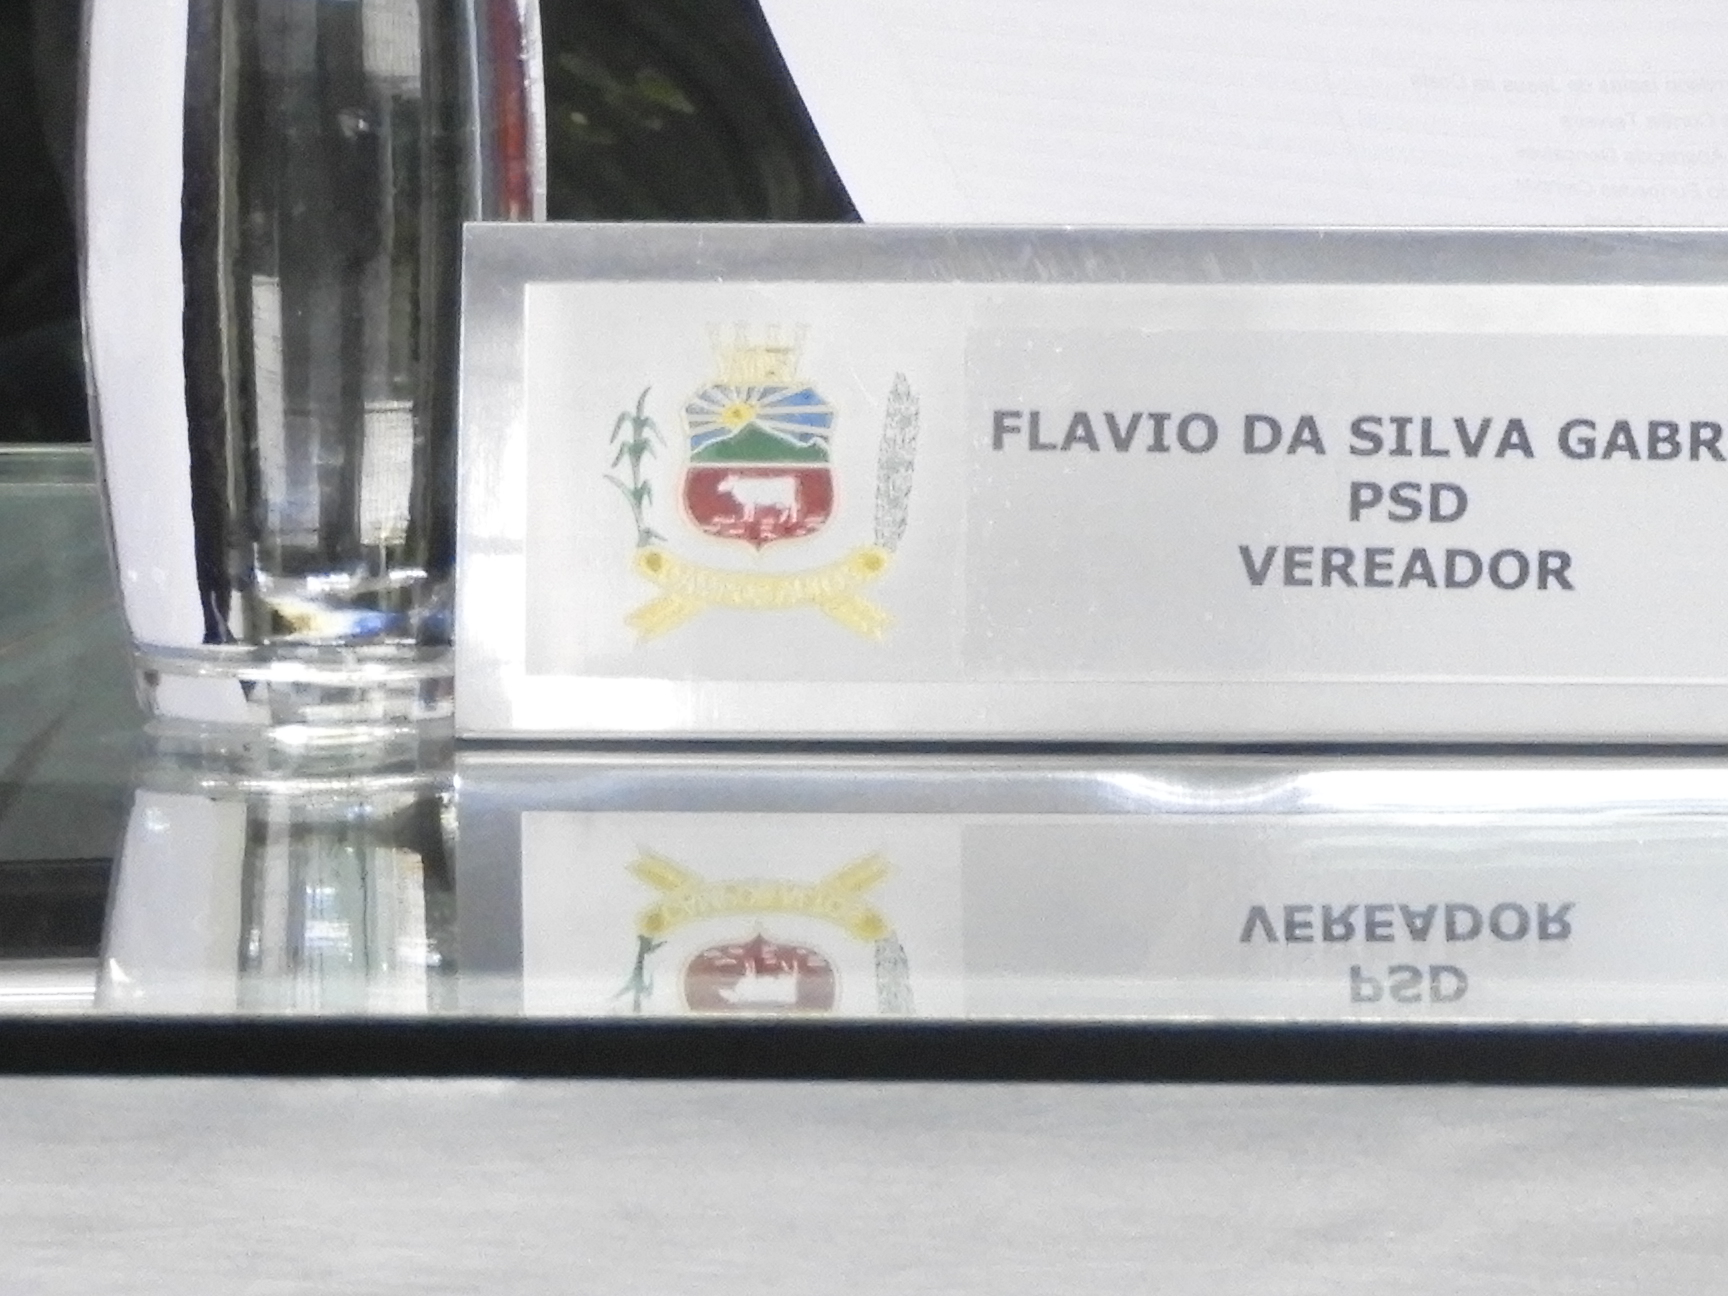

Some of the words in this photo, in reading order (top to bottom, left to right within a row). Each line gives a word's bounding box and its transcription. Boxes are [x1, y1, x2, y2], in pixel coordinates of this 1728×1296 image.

[993, 411, 1218, 454] FLAVIO
[1244, 414, 1325, 455] DA
[1350, 416, 1534, 458] SILVA
[1350, 482, 1468, 522] PSD
[1239, 545, 1573, 590] VEREADOR
